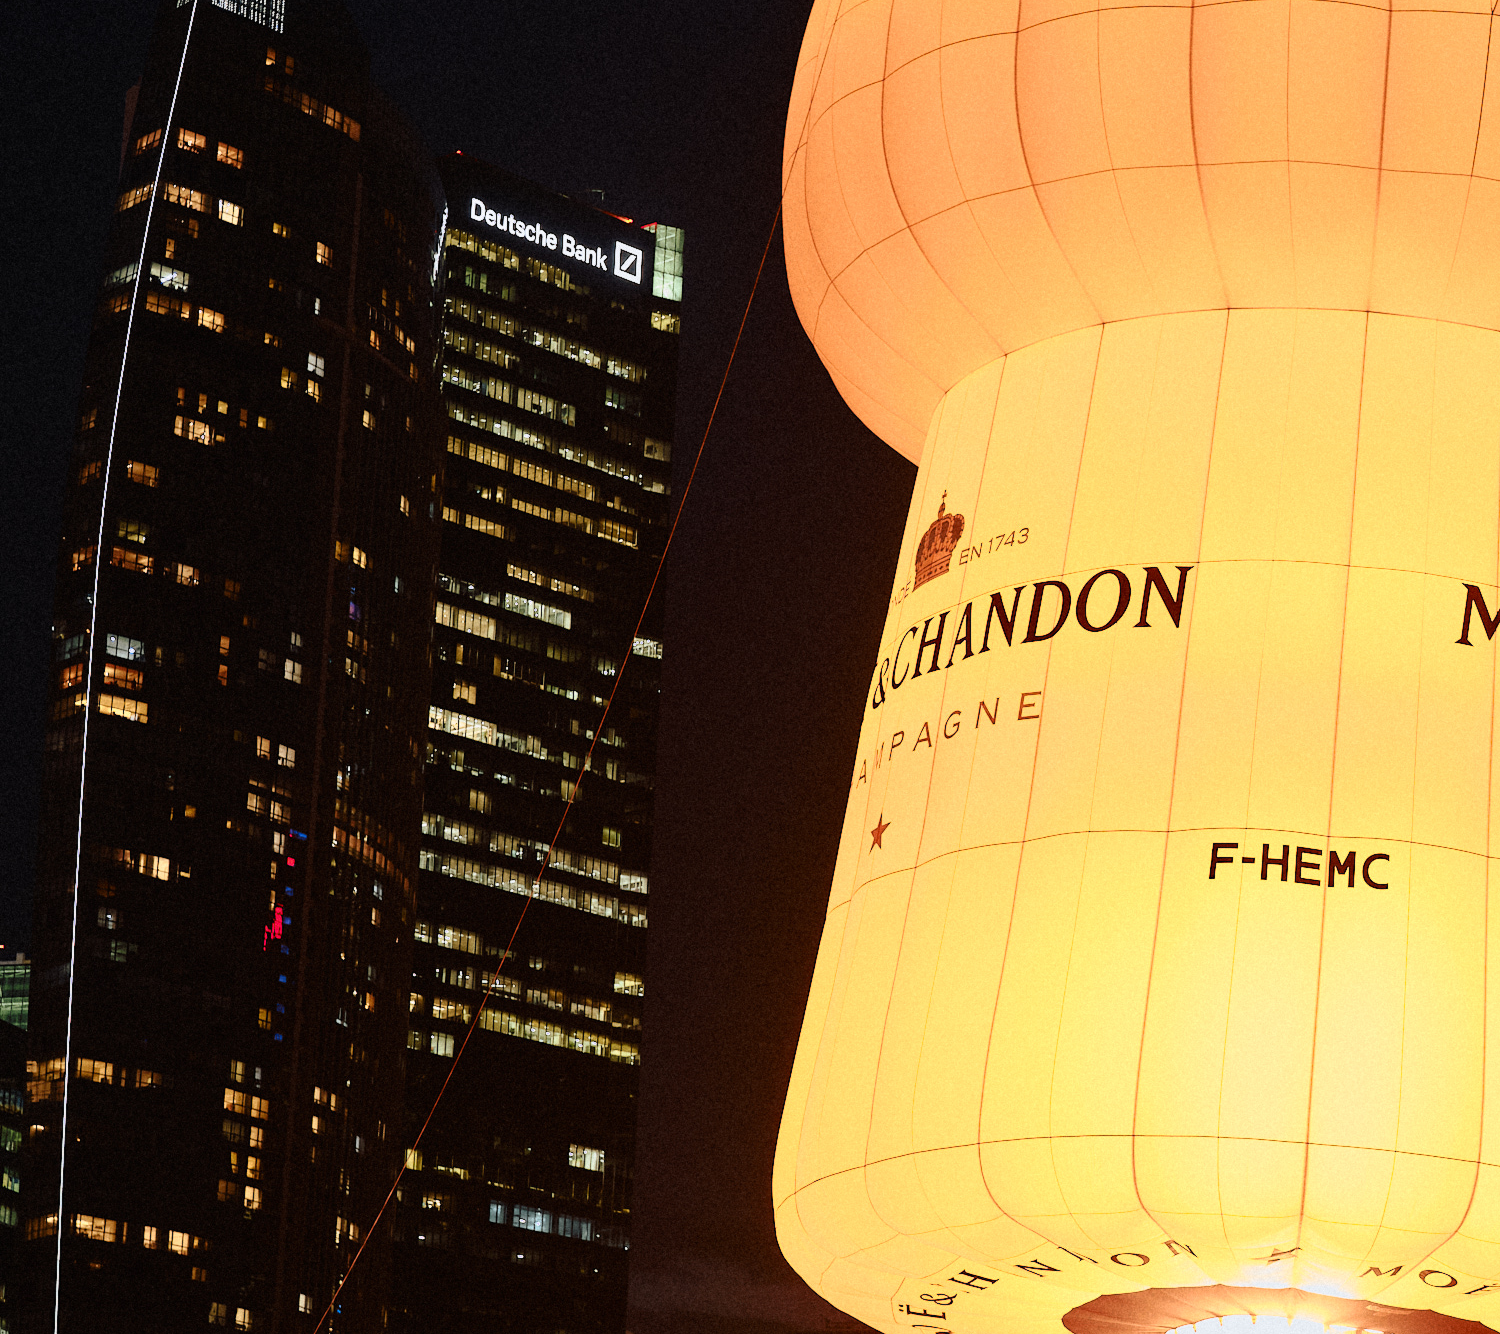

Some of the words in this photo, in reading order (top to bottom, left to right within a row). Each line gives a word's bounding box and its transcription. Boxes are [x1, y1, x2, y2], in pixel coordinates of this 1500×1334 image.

[470, 197, 558, 251] Deutsche
[562, 233, 608, 272] Bank
[959, 543, 983, 566] EN
[987, 527, 1030, 555] 1743
[856, 690, 1042, 789] AMPAGNE
[1208, 842, 1390, 890] F-HEMC
